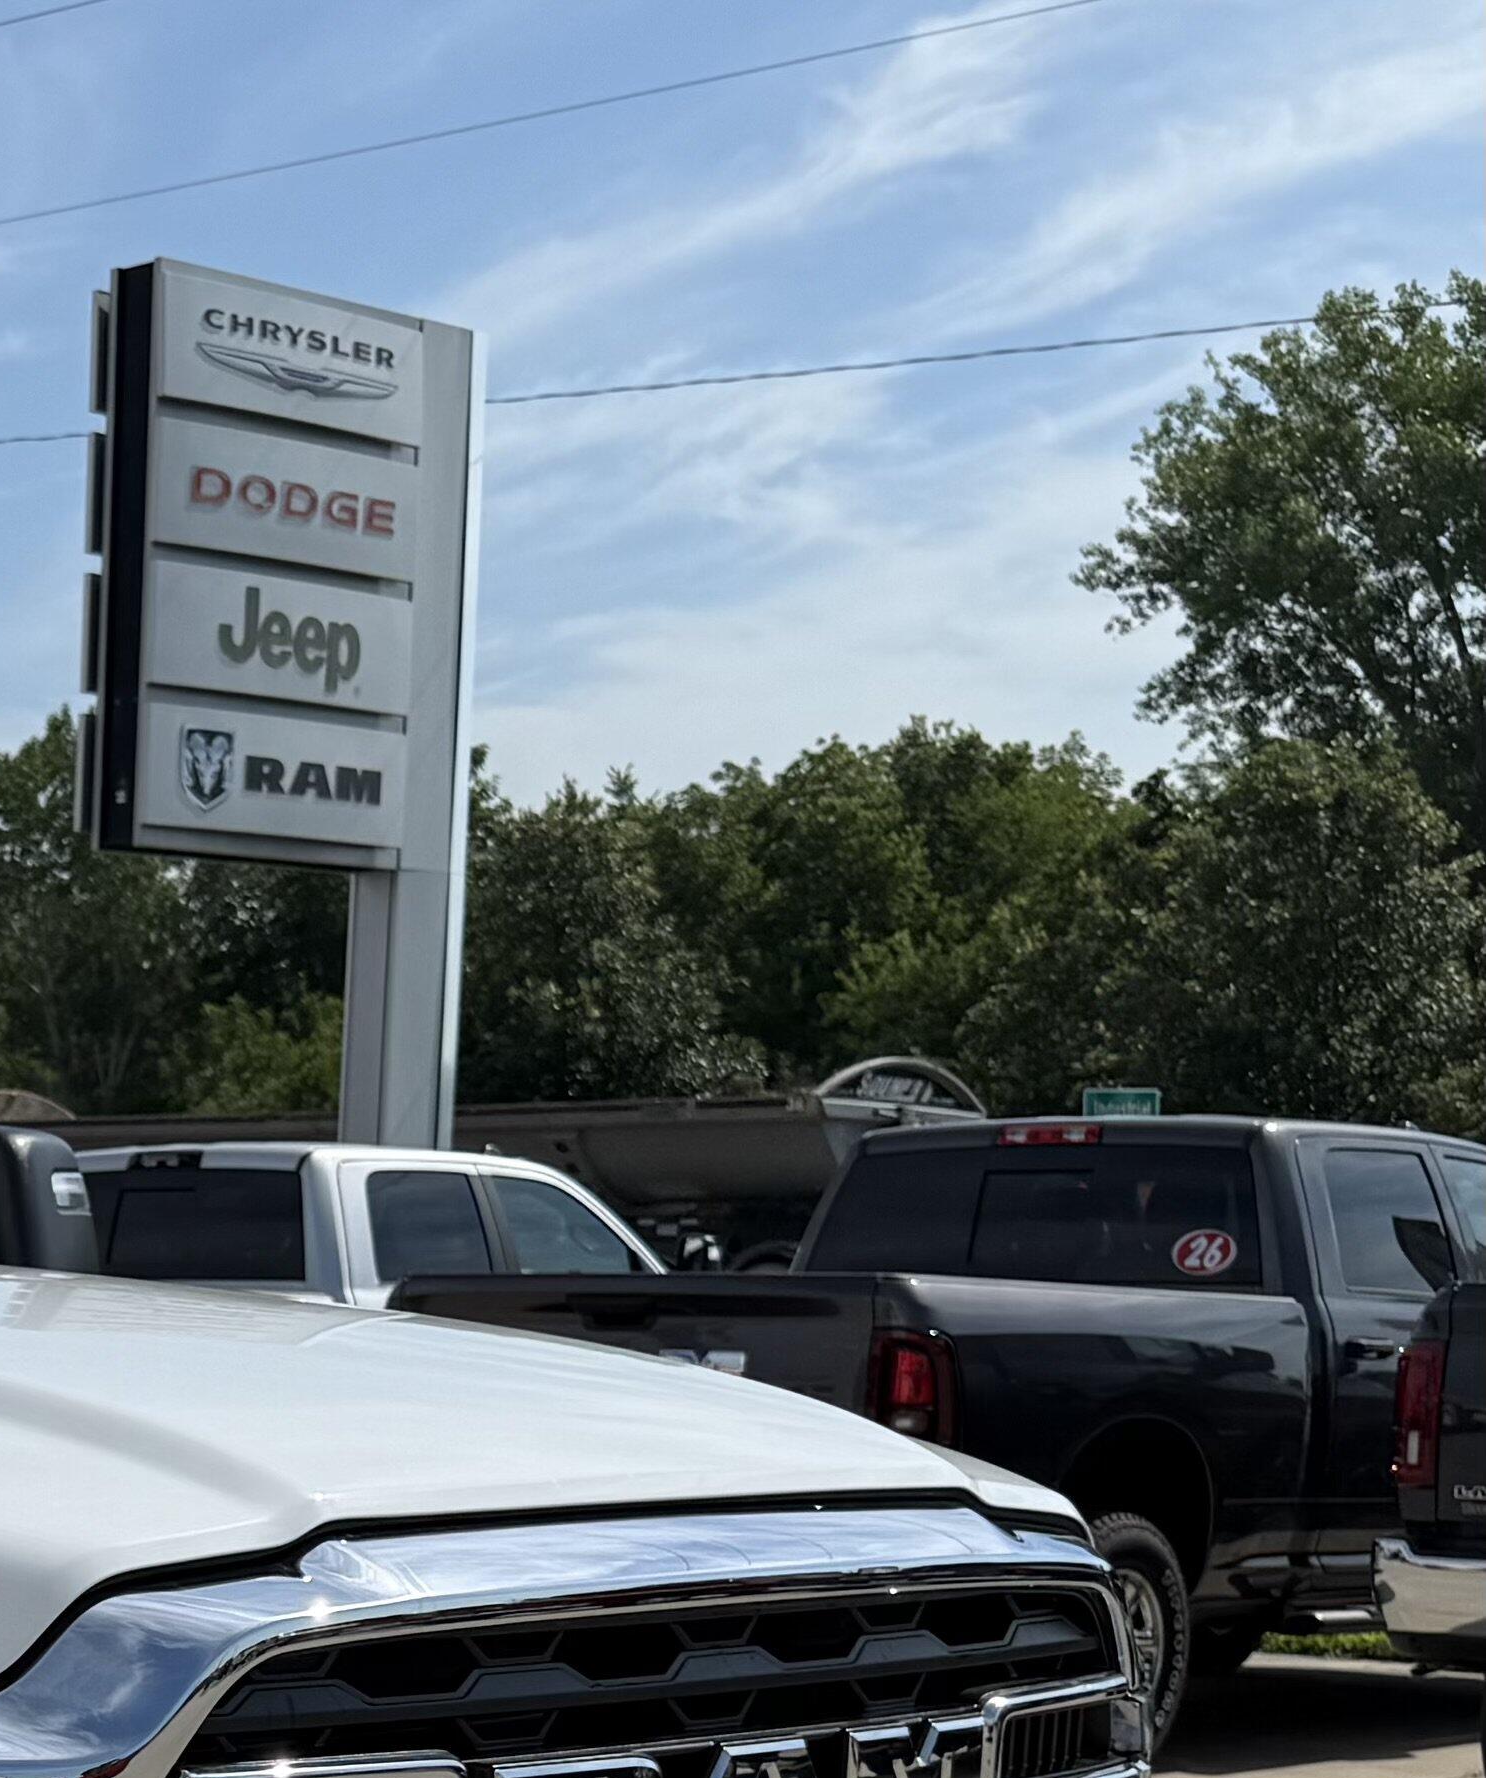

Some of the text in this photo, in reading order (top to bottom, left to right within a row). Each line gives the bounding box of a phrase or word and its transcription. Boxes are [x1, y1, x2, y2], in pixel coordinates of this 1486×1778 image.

[201, 308, 396, 370] CHRYSLER
[190, 466, 396, 537] DODGE
[218, 586, 361, 694] Jeep
[244, 755, 382, 806] RAM
[1184, 1235, 1225, 1269] 26
